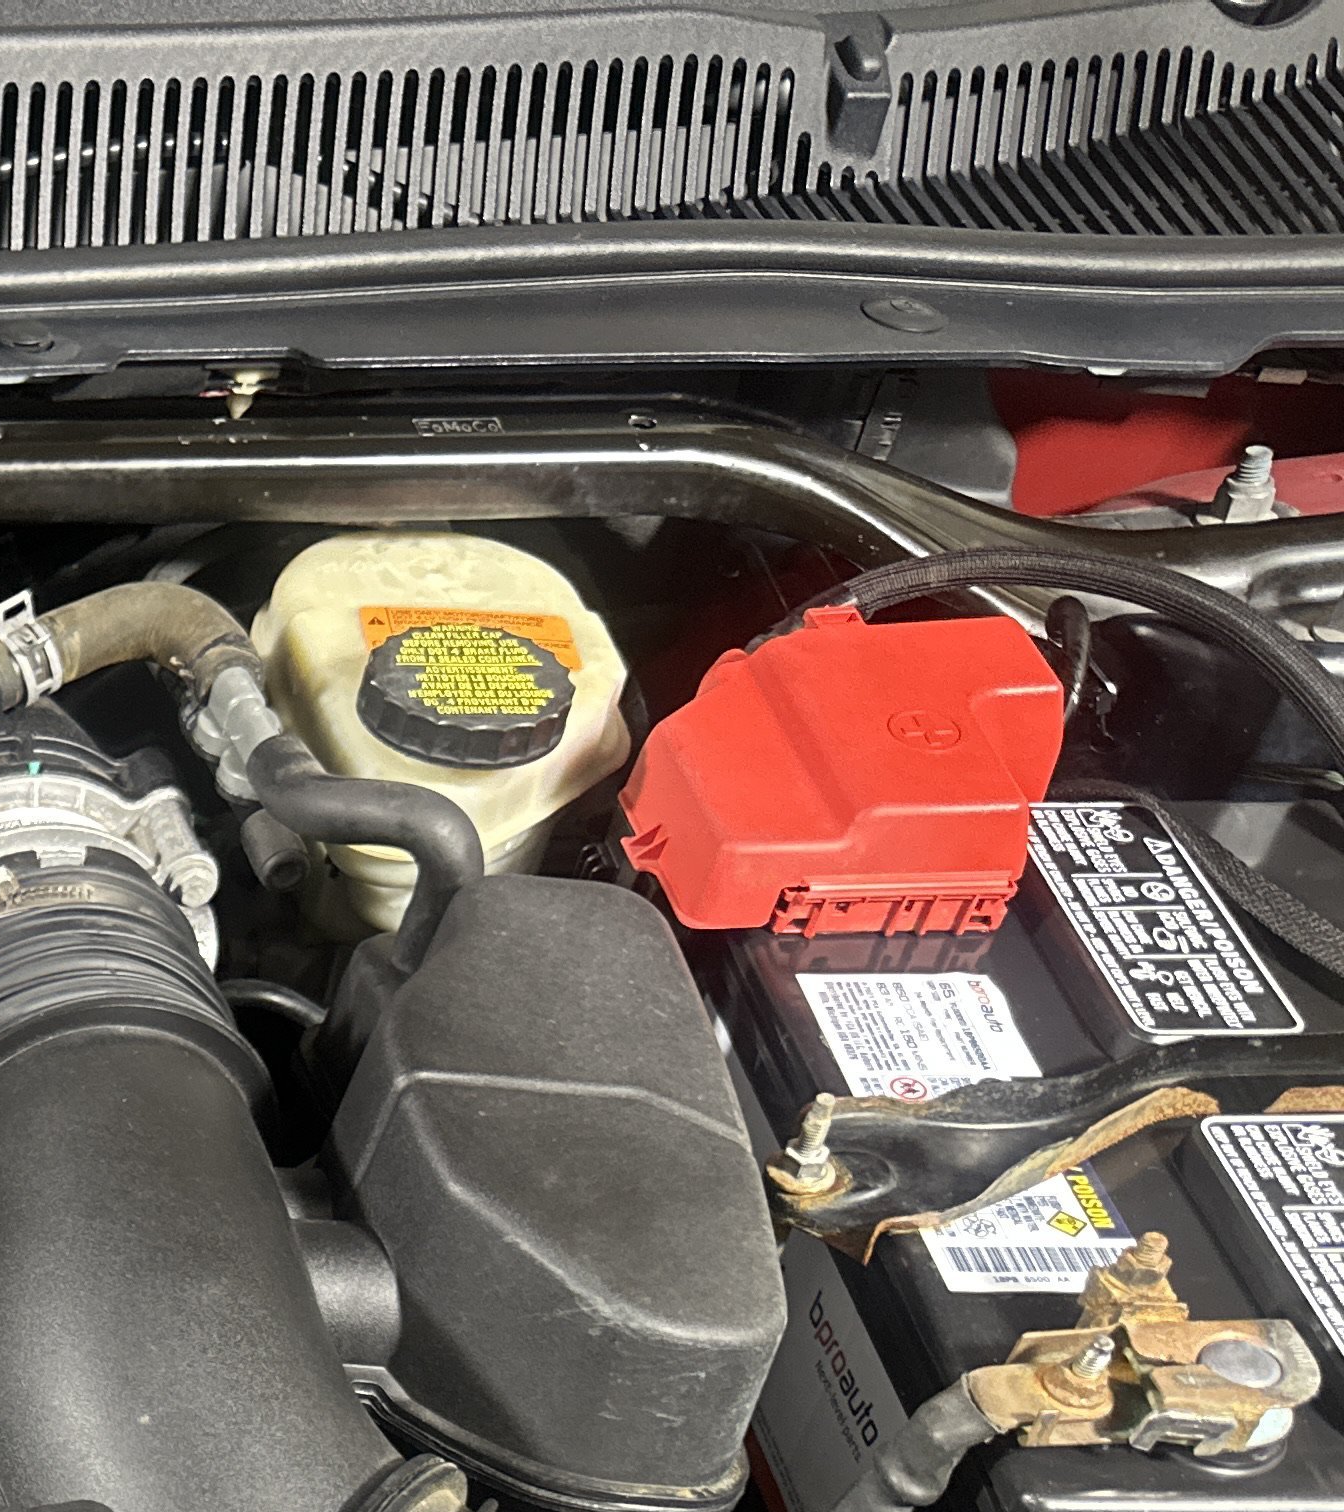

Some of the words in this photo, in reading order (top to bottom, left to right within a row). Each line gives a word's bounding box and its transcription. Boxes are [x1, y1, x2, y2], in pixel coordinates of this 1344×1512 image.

[417, 420, 500, 433] FoMoCo
[402, 639, 441, 648] BEFORE
[498, 639, 520, 647] USE
[412, 632, 445, 640] CLEAN
[446, 632, 480, 640] FILLER
[481, 631, 503, 639] CAP
[395, 655, 427, 663] FROM
[428, 656, 437, 664] A
[438, 655, 477, 664] SEALED
[400, 647, 425, 655] ONLY
[427, 647, 448, 656] DOT
[450, 647, 460, 656] 4
[462, 647, 497, 656] BRAKE
[498, 647, 529, 655] FLUID
[1087, 827, 1114, 853] SHIELD
[1103, 853, 1128, 873] EYES
[1154, 853, 1264, 994] DANGER/POISON
[938, 981, 956, 999] 65
[1263, 1124, 1308, 1173] EXPLOSIVE
[1296, 1174, 1329, 1205] GASES
[1065, 1173, 1116, 1230] POISON
[808, 1289, 879, 1448] bproauto
